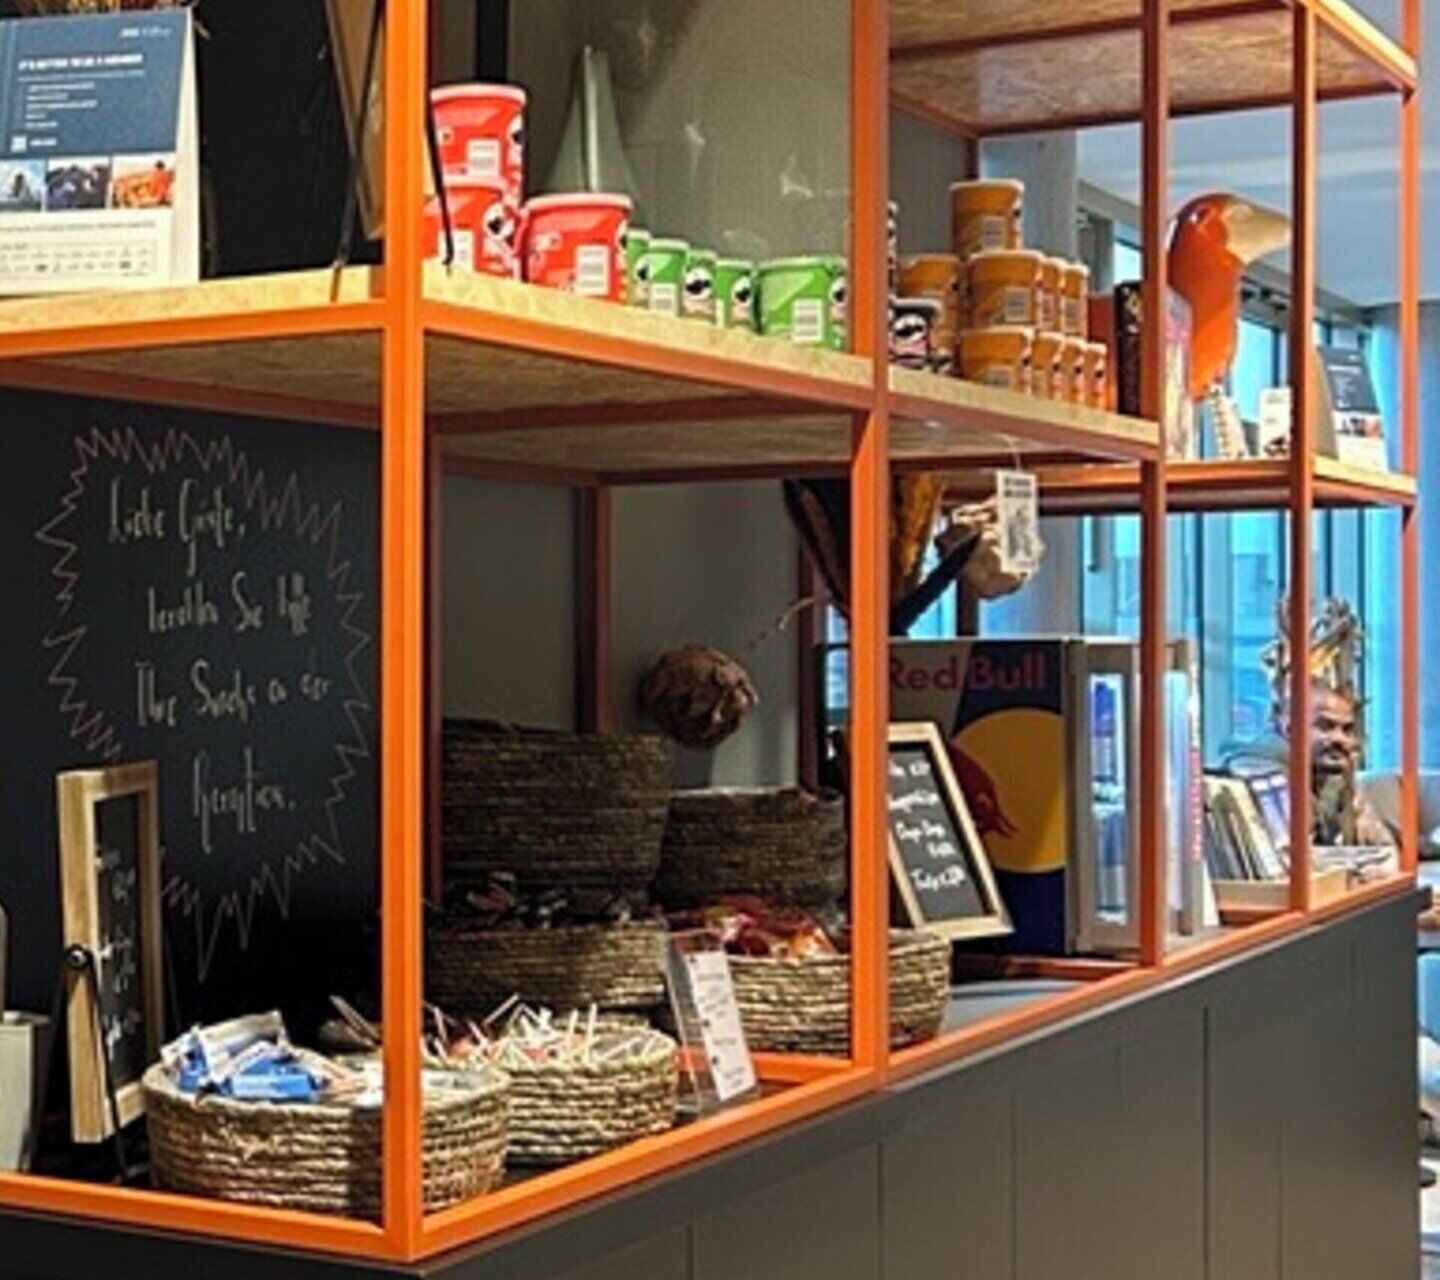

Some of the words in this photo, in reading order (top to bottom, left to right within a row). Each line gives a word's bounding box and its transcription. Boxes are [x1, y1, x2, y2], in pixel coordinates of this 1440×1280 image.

[231, 571, 263, 633] Sie
[890, 653, 958, 690] Red
[967, 649, 1046, 690] Bull
